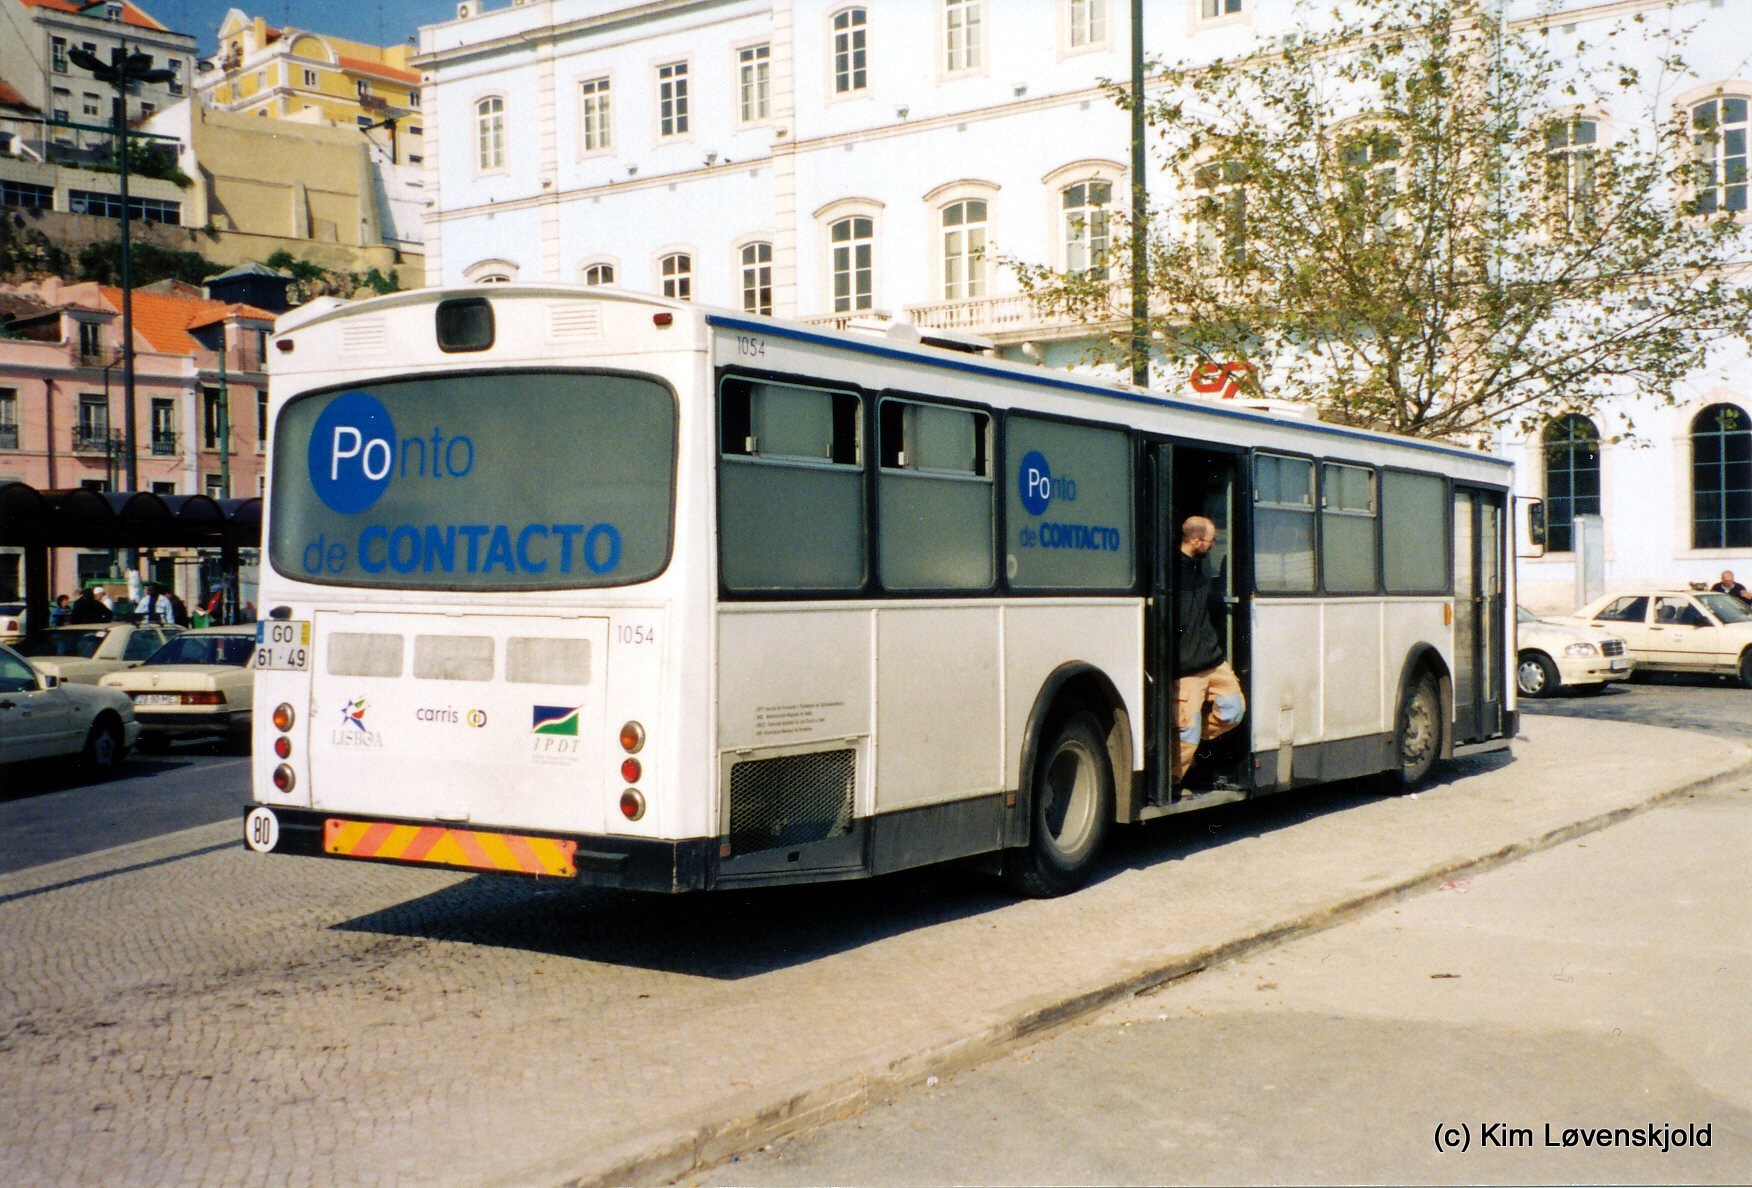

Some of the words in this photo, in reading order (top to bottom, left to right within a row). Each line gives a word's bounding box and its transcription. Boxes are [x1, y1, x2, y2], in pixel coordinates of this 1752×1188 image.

[736, 336, 766, 358] 1054
[331, 425, 475, 481] Ponto
[1028, 467, 1077, 502] Ponto
[303, 531, 347, 575] de
[358, 522, 622, 575] CONTACTO
[1019, 524, 1038, 548] de
[1040, 522, 1120, 552] CONTACTO
[272, 624, 294, 644] GO
[618, 625, 655, 645] 1054
[416, 704, 459, 724] carris
[332, 730, 384, 748] LISBOA
[254, 815, 271, 846] 80
